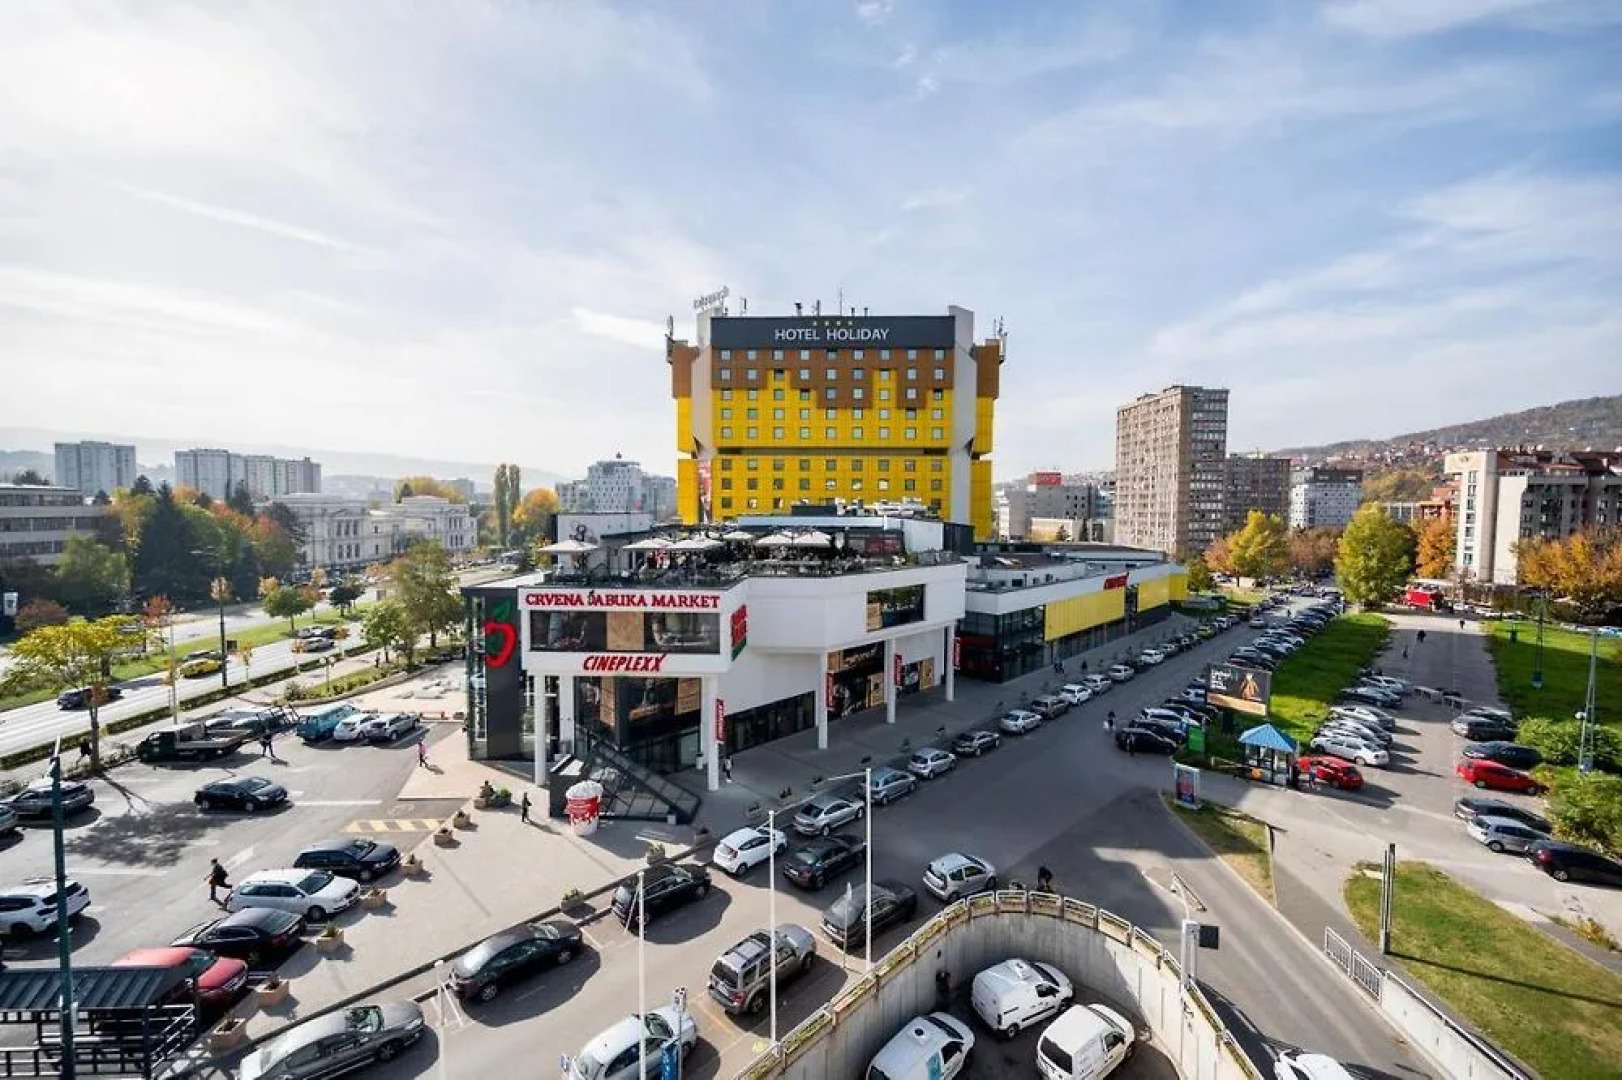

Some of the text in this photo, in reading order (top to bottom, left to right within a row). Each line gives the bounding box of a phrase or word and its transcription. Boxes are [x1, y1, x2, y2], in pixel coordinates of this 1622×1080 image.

[774, 328, 890, 341] HOTEL HOLIDAY
[525, 593, 584, 606] CRVENA
[651, 594, 720, 608] MARKET
[583, 651, 668, 671] CINEPLEXX
